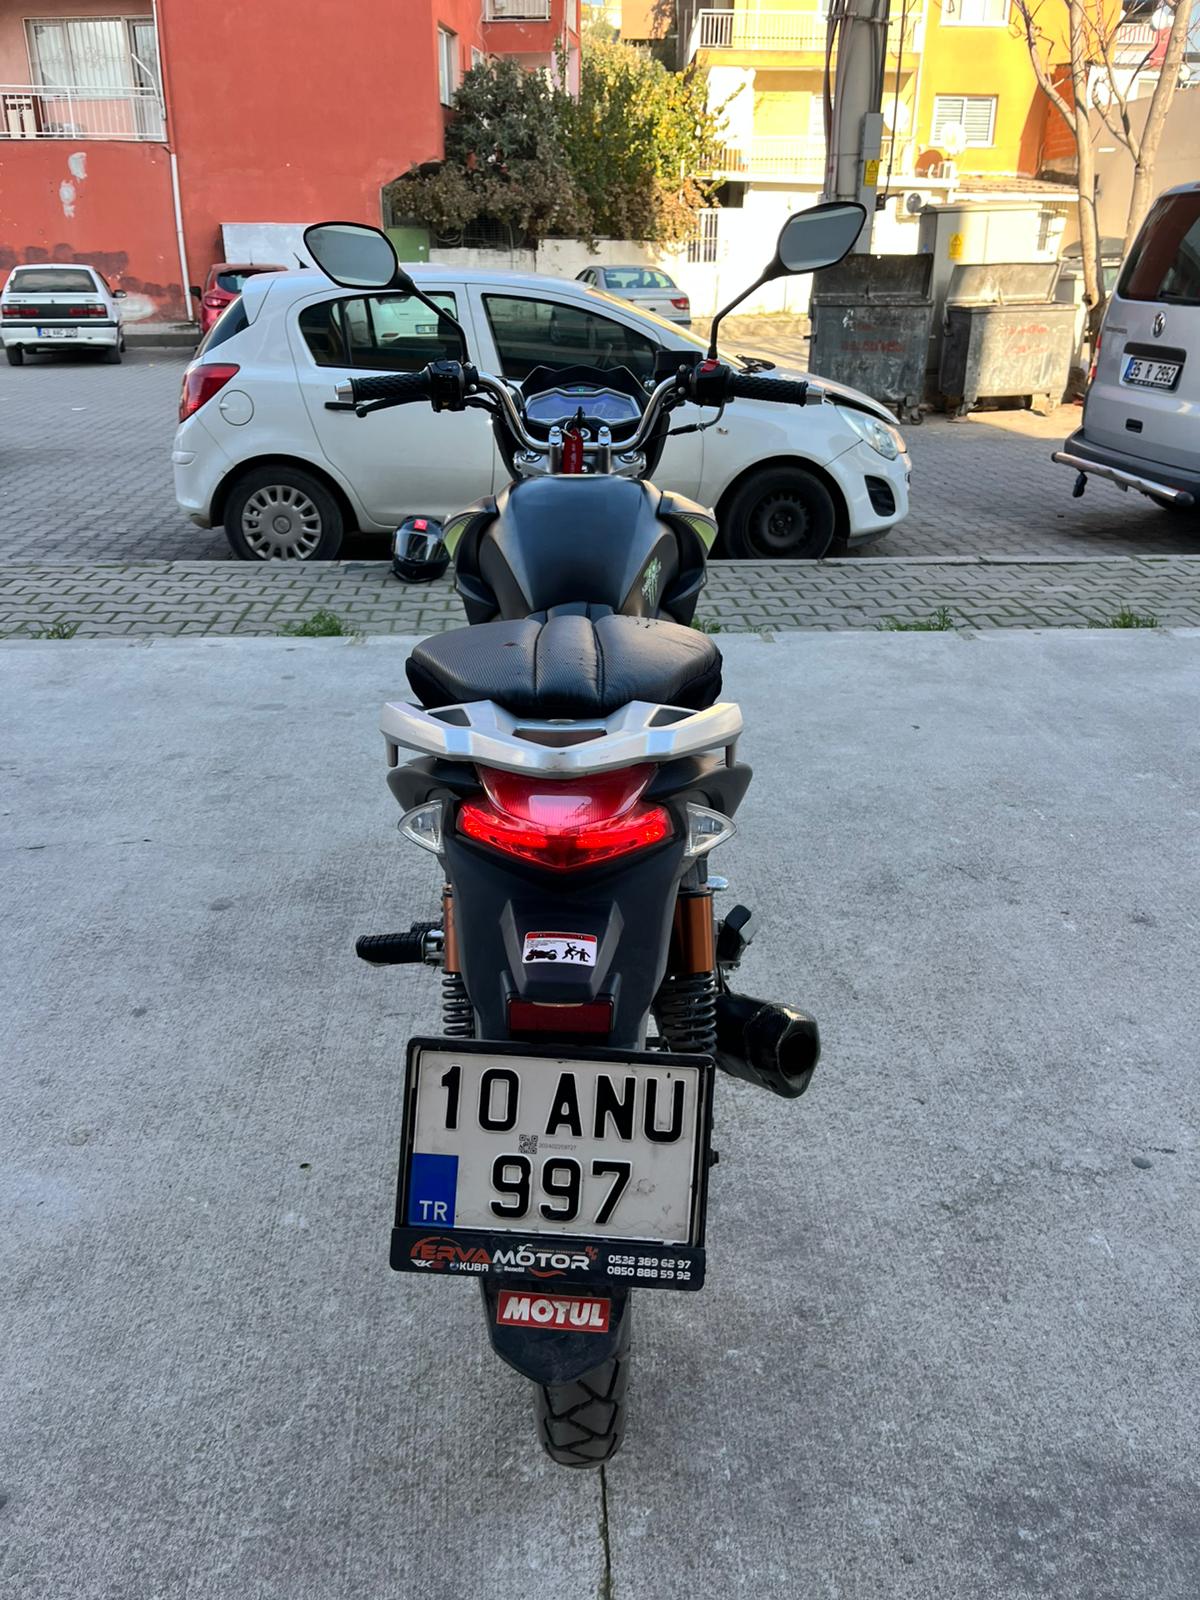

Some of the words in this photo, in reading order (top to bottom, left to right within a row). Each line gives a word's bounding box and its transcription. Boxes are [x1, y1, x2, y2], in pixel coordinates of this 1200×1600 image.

[441, 1065, 519, 1132] 10
[545, 1072, 686, 1143] ANU
[489, 1154, 632, 1224] 997
[418, 1199, 447, 1222] TR
[459, 1261, 490, 1273] KUBA
[492, 1248, 590, 1271] MOTOR
[608, 1254, 636, 1265] 0532
[660, 1258, 676, 1268] 62
[677, 1259, 692, 1269] 97
[606, 1265, 635, 1276] 0850
[636, 1267, 658, 1278] 888
[660, 1269, 675, 1279] 59
[676, 1270, 691, 1280] 92
[502, 1296, 605, 1327] MOTUL
